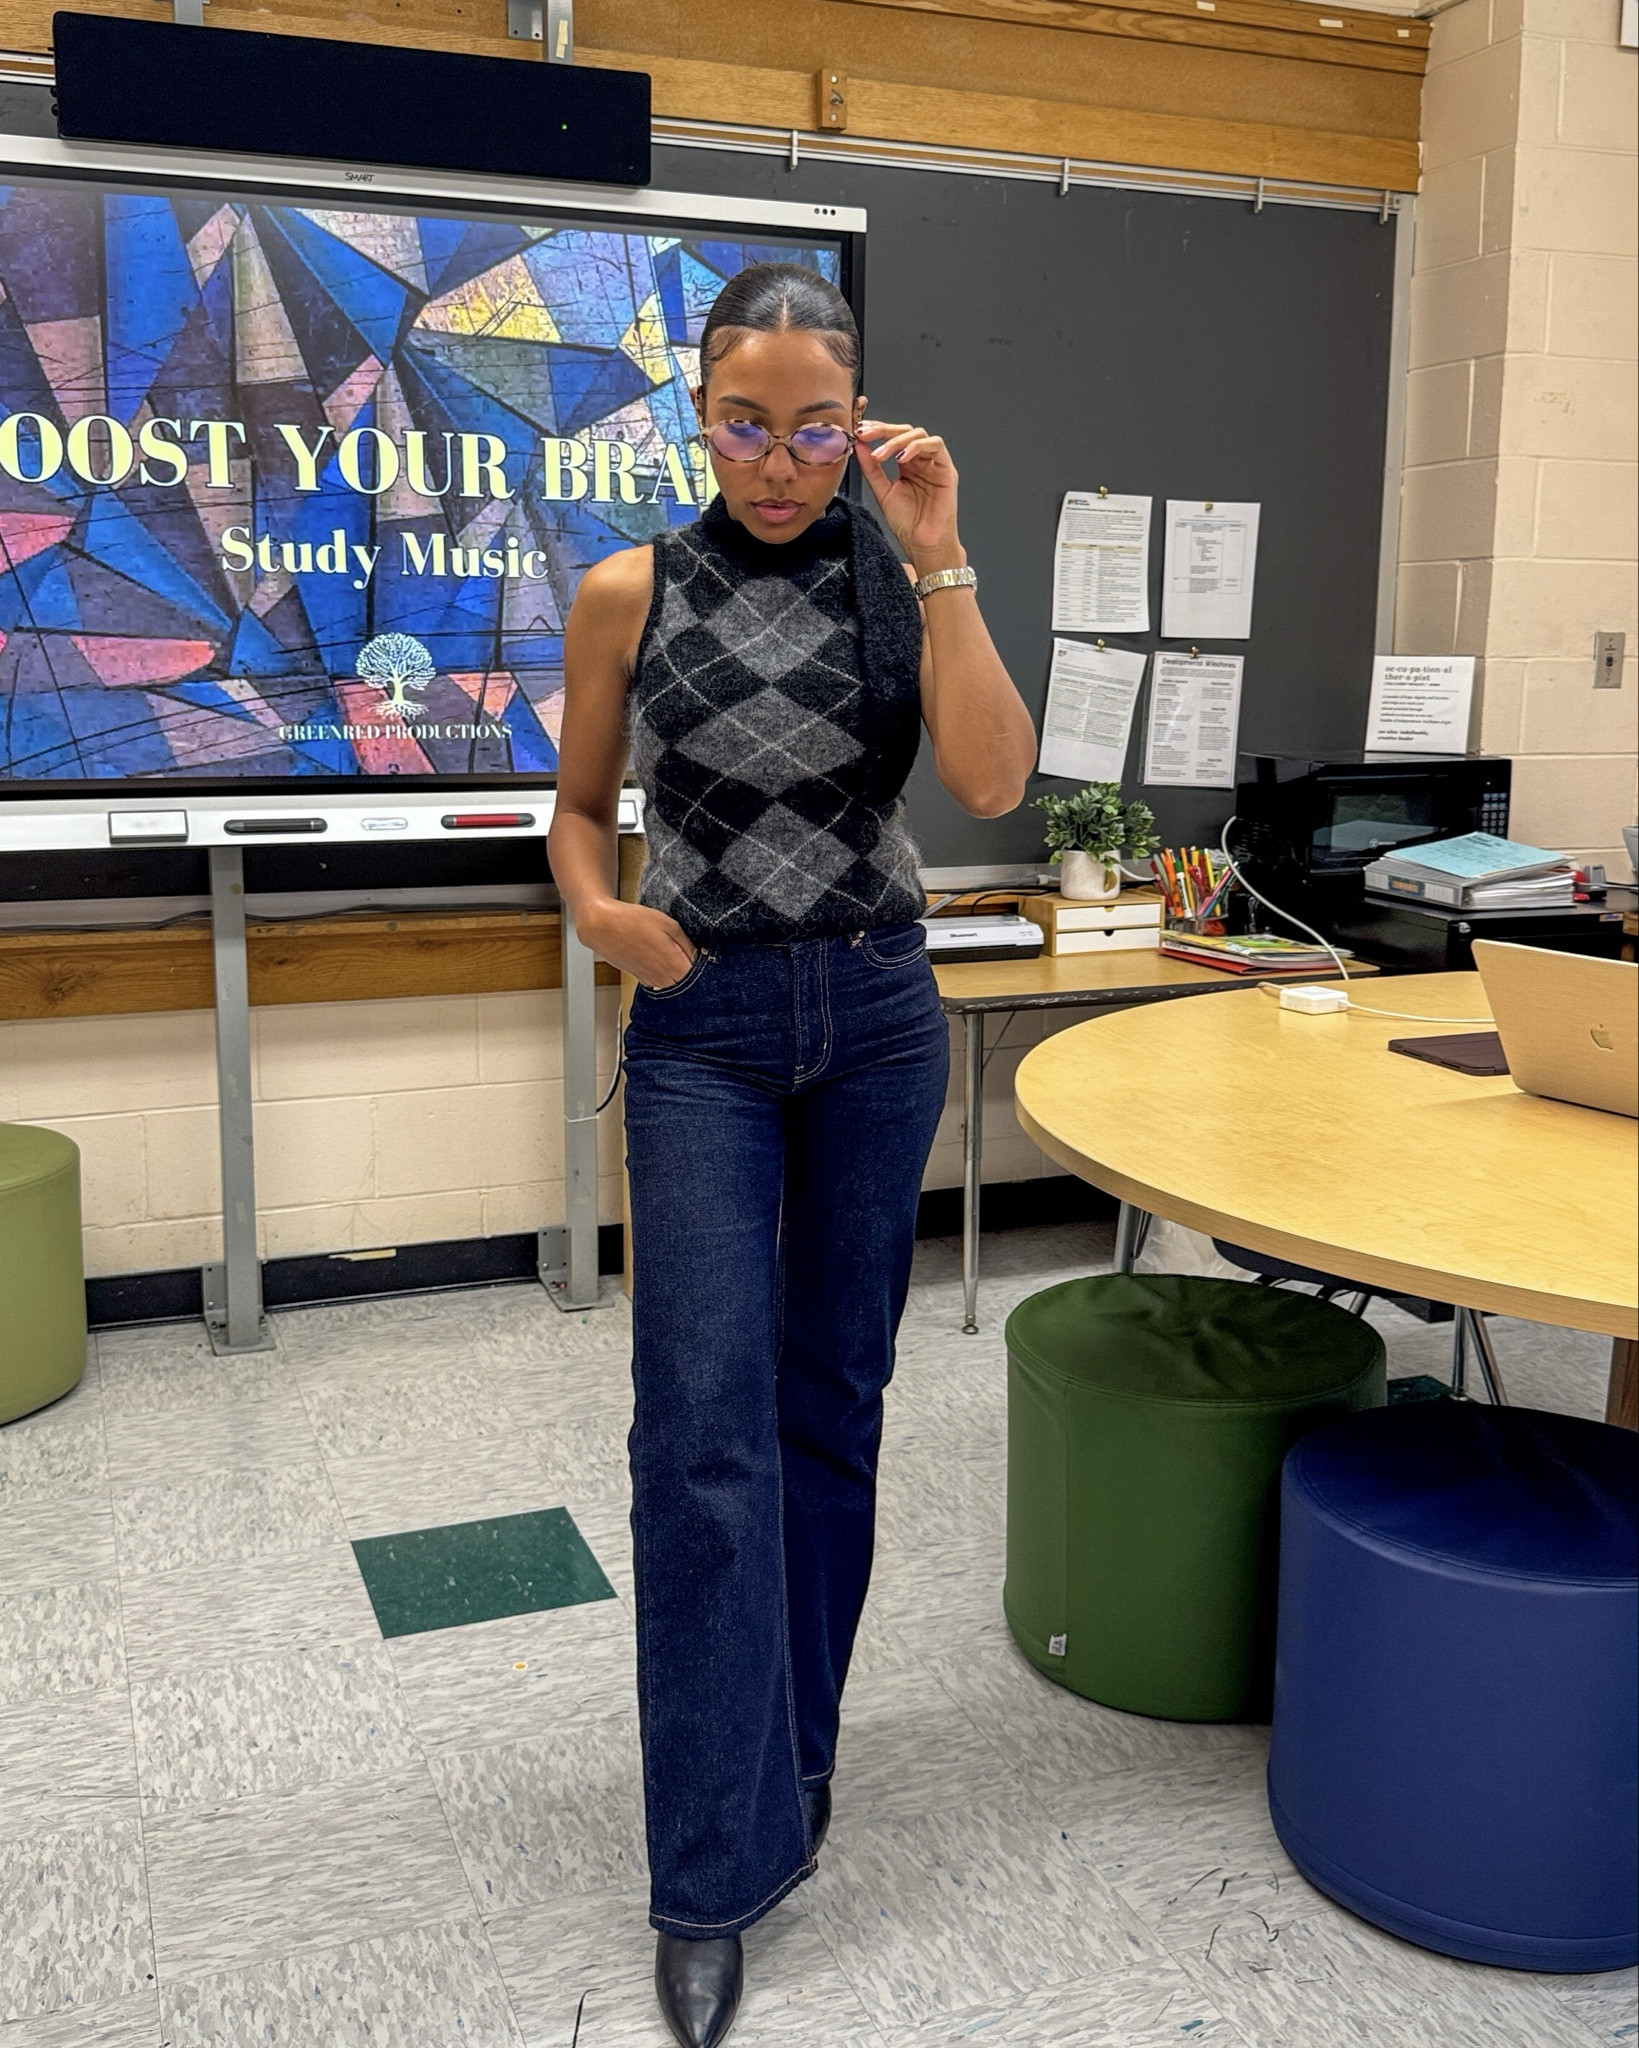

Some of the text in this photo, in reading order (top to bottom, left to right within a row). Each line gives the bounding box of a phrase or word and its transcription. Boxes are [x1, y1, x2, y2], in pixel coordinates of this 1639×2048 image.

[345, 171, 375, 183] SMART
[273, 422, 517, 500] YOUR
[220, 525, 550, 590] Study Music
[278, 723, 513, 741] GREENRED PRODUCTIONS
